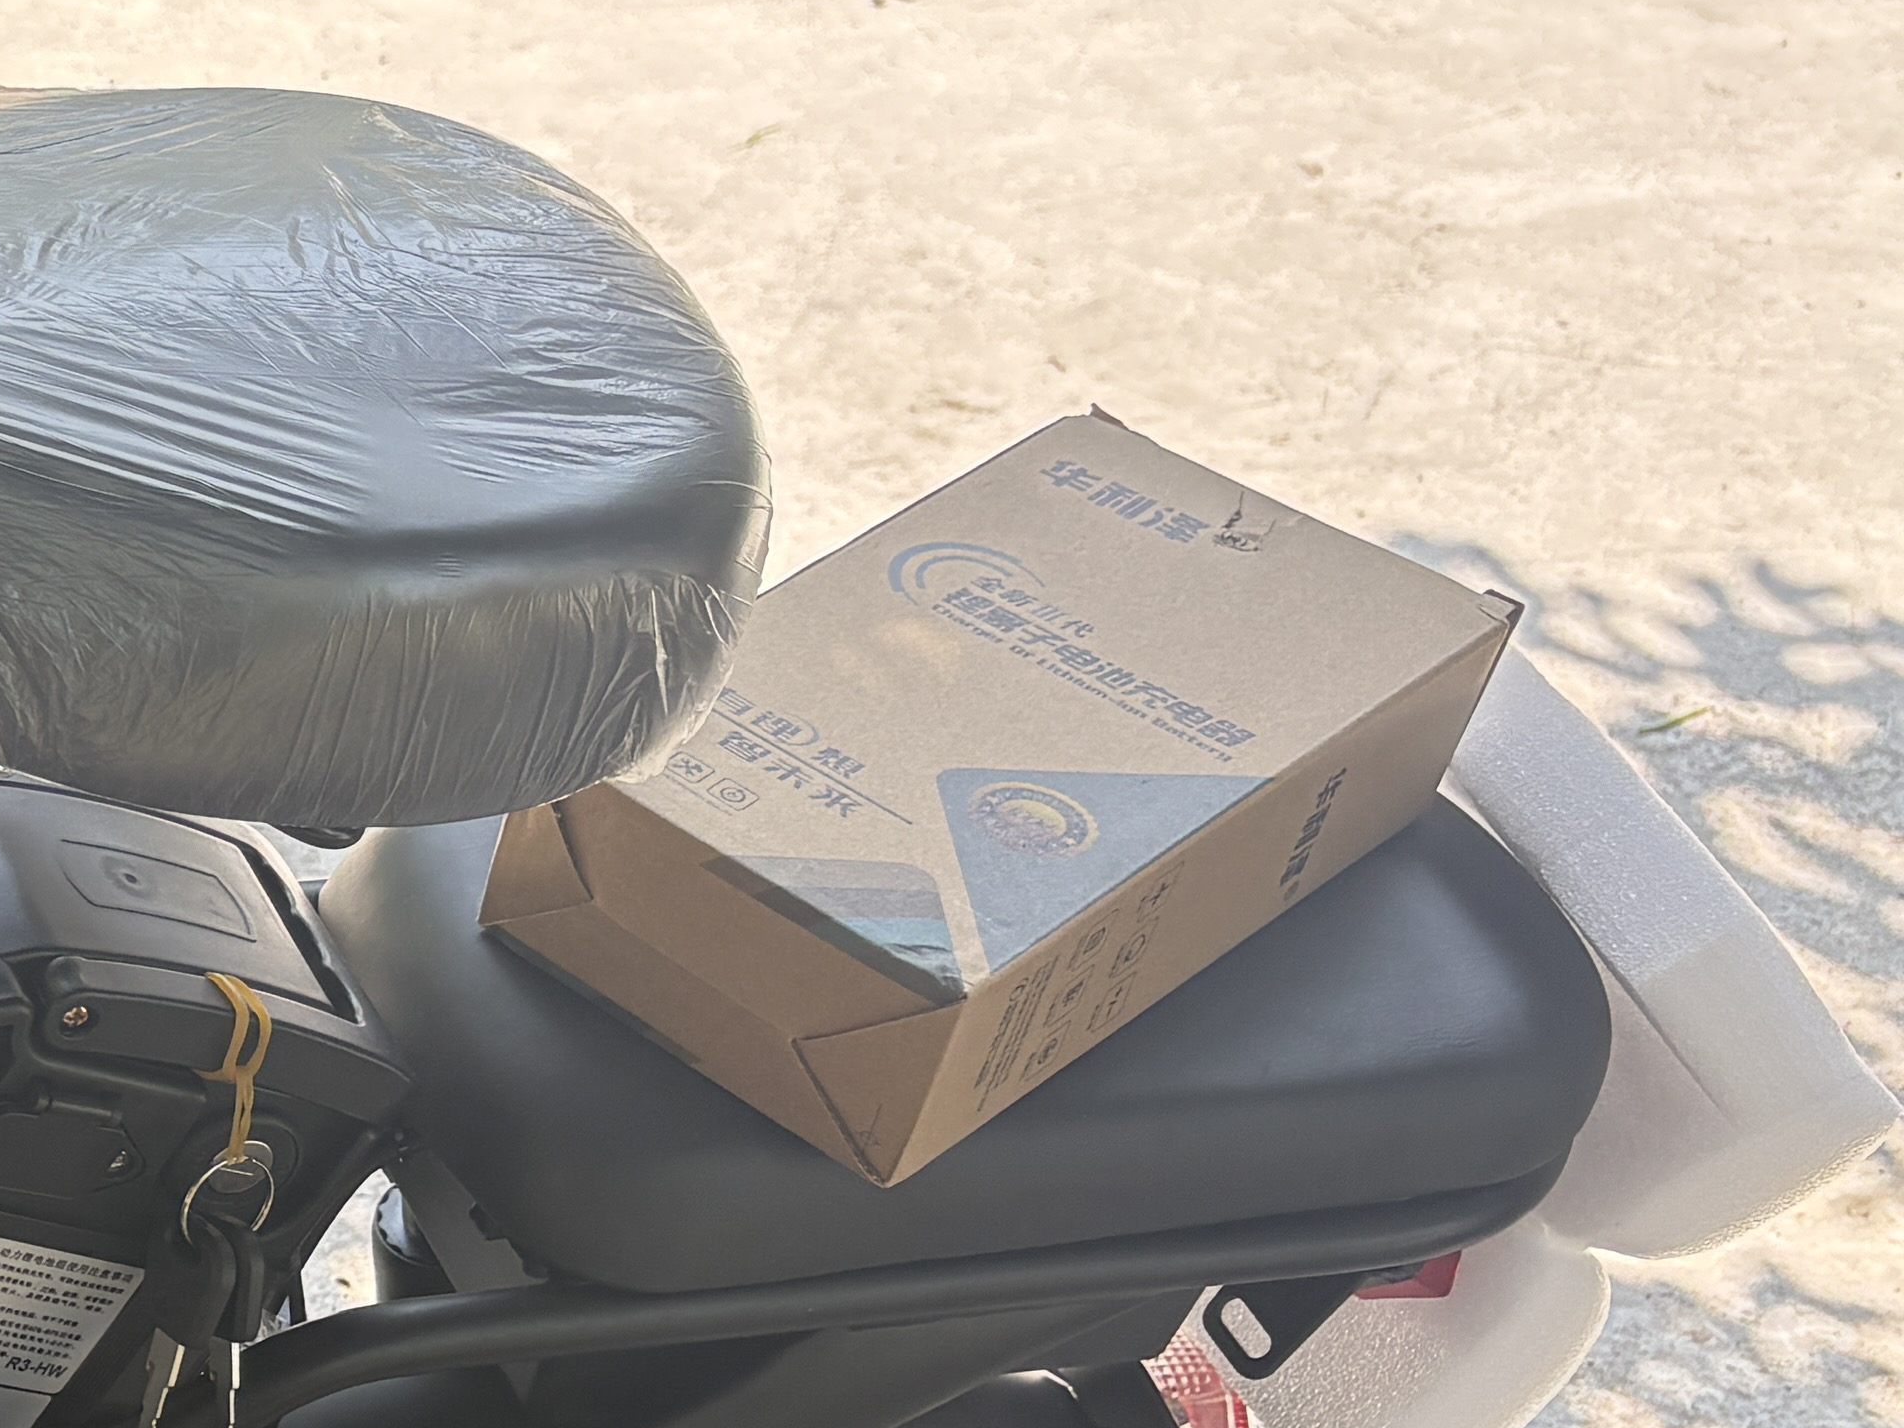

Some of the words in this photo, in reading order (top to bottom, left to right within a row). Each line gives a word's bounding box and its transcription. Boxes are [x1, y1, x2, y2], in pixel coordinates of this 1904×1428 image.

[941, 586, 1257, 749] 锂离子电池充电器
[4, 1356, 69, 1379] R3-HW
